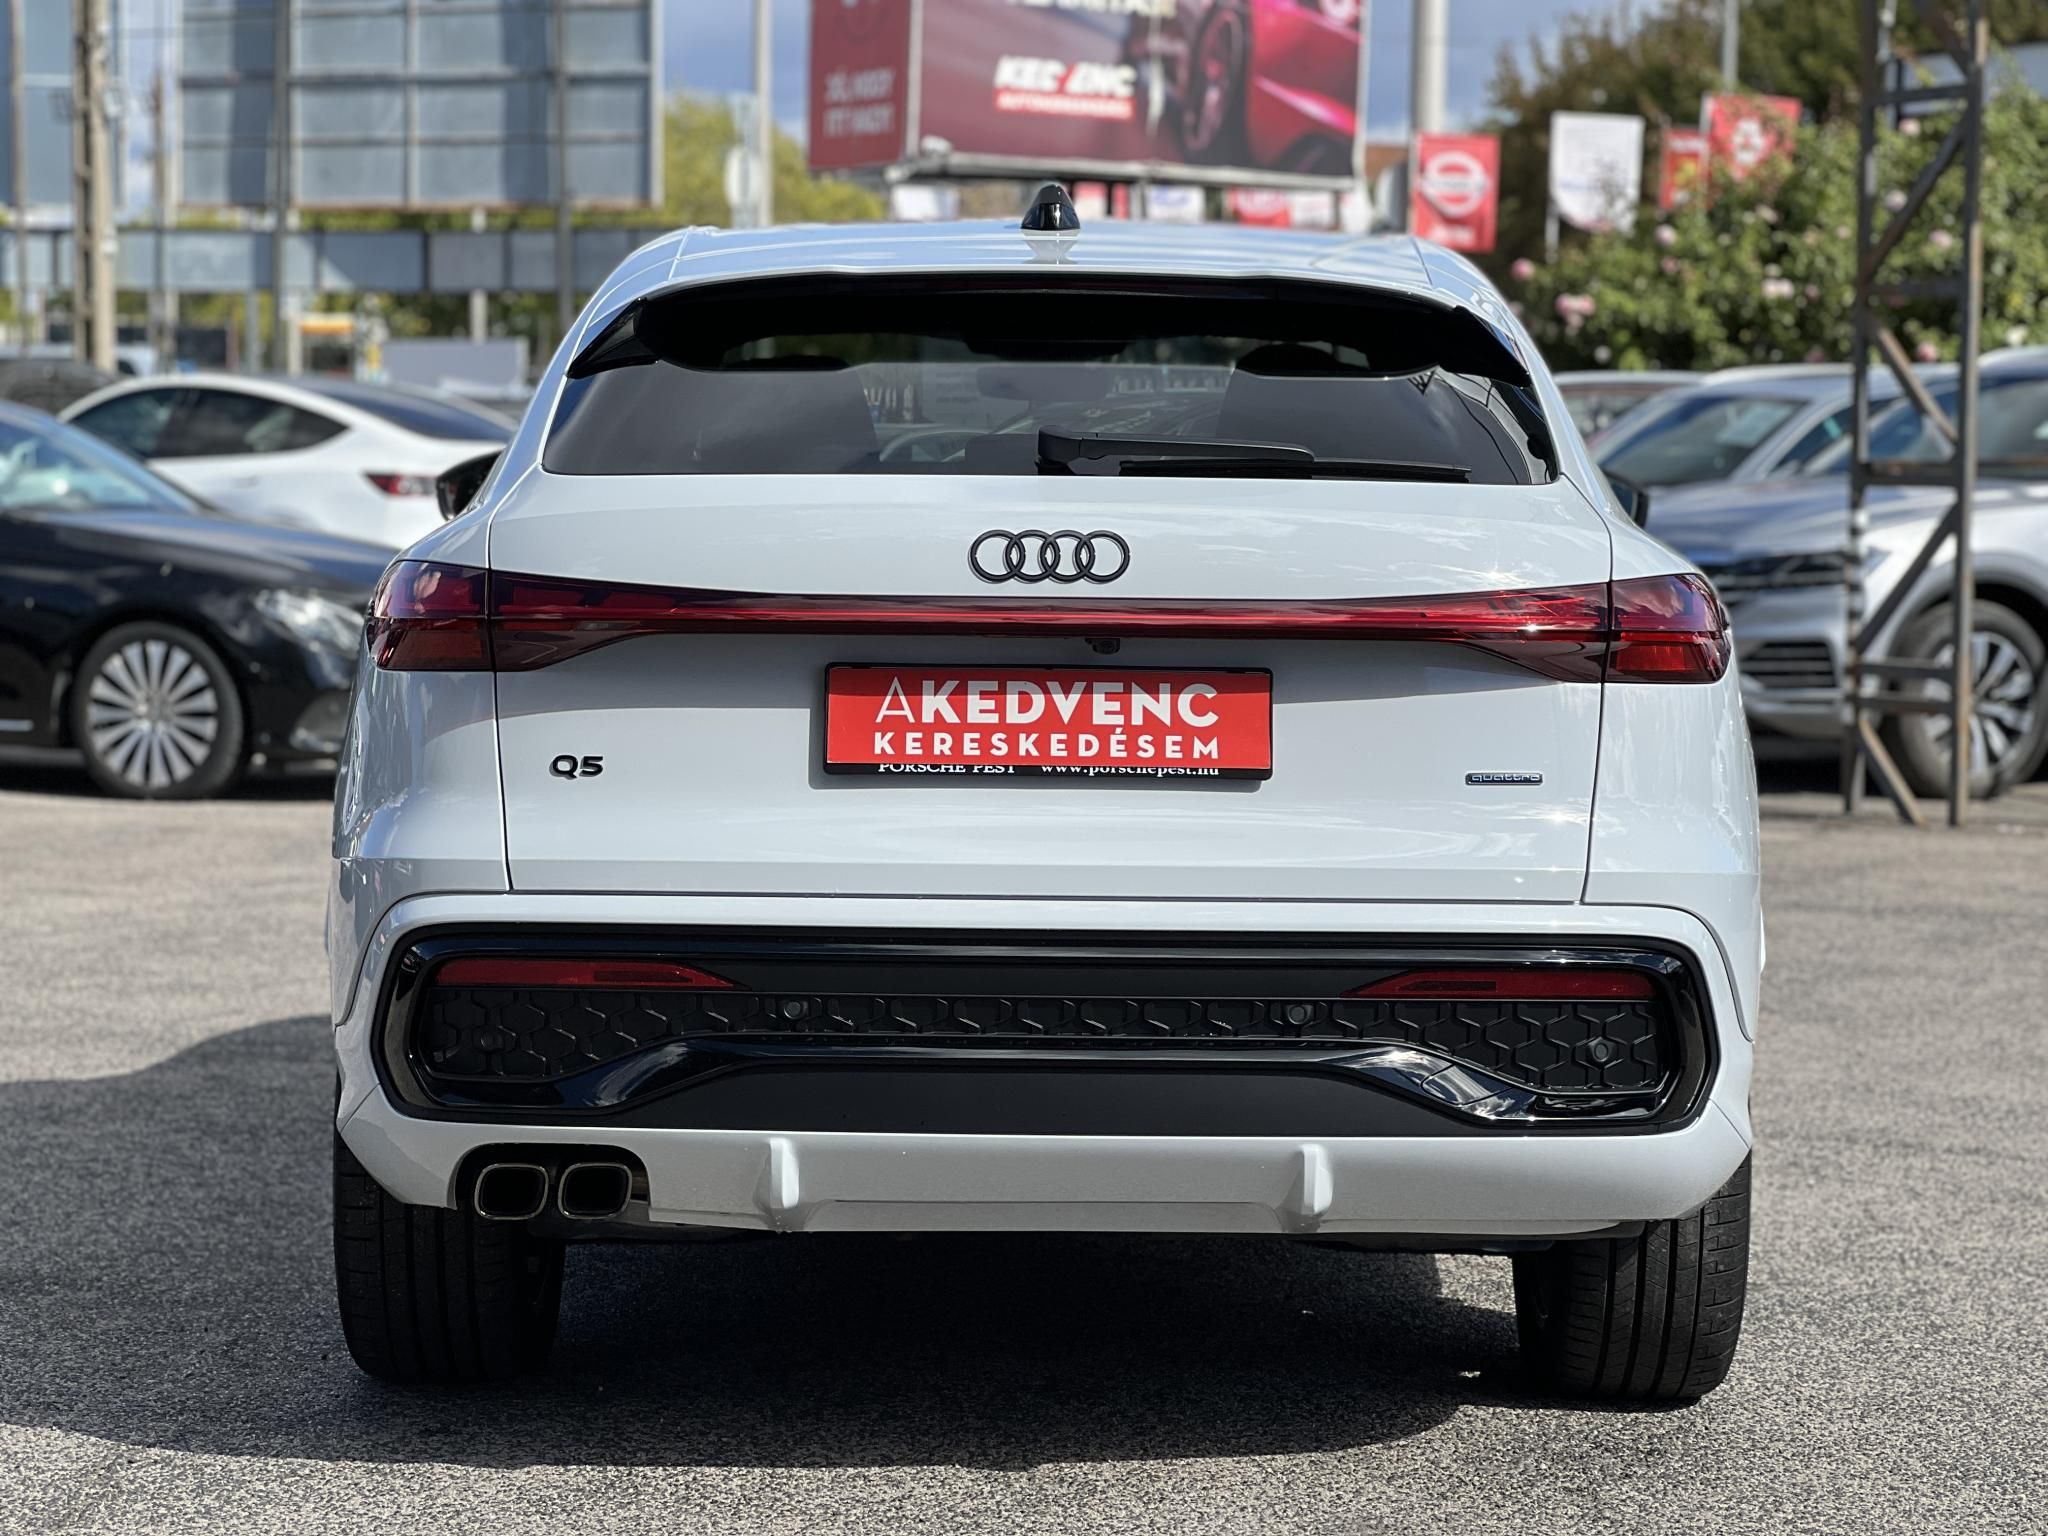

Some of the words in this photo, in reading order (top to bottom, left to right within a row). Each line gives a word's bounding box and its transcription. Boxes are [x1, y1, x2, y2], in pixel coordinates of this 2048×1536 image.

[874, 728, 1219, 759] KERESKEDÉSEM
[549, 754, 603, 780] Q5
[878, 763, 966, 773] PORSCHE
[973, 764, 1016, 774] PEST
[1472, 774, 1540, 782] quattro
